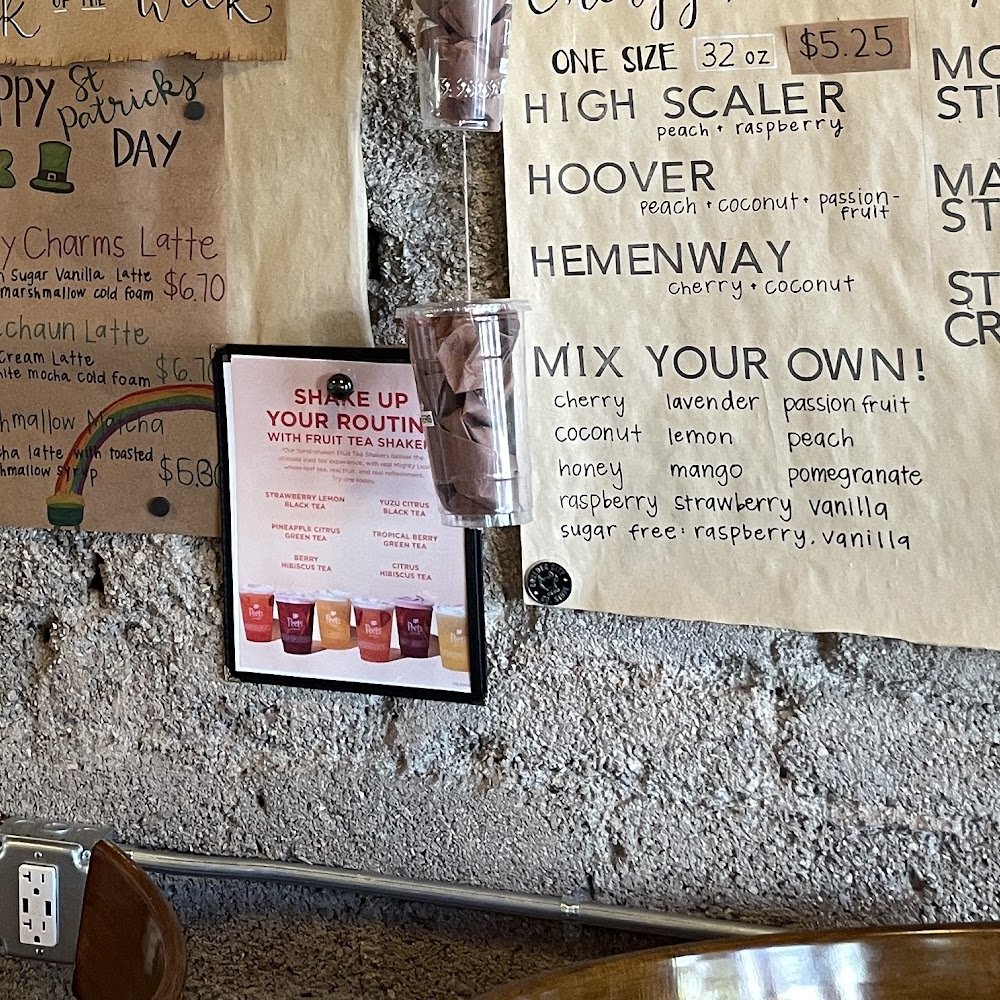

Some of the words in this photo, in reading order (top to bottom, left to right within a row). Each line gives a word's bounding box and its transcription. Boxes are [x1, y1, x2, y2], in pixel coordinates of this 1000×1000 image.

[799, 25, 893, 61] $5.25
[664, 81, 845, 118] SCALER
[657, 122, 709, 140] peach
[736, 117, 844, 141] raspberry
[529, 159, 715, 195] HOOVER
[640, 197, 697, 215] peach
[718, 195, 799, 213] coconut
[24, 226, 124, 260] Charms
[141, 227, 218, 260] Latte
[530, 241, 791, 277] HEMENWAY
[56, 267, 104, 282] Vanilla
[117, 269, 152, 282] Latte
[163, 269, 225, 301] $6.70
[93, 287, 117, 300] cold
[124, 287, 153, 301] foam
[668, 279, 743, 300] cherry
[765, 275, 855, 294] coconut
[85, 318, 149, 345] Latte
[52, 351, 95, 366] Latte
[379, 392, 408, 409] UP
[554, 392, 625, 416] cherry
[666, 393, 760, 411] lavender
[266, 411, 328, 430] YOUR
[268, 432, 301, 443] WITH
[306, 433, 342, 446] FRUIT
[348, 435, 372, 447] TEA
[555, 425, 642, 443] coconut
[667, 428, 733, 445] lemon
[110, 447, 154, 462] toasted
[788, 464, 923, 488] pomegranate
[266, 492, 316, 501] STRAWBERRY
[379, 499, 400, 508] YUZU
[402, 500, 430, 509] CITRUS
[559, 492, 658, 517] raspberry
[674, 495, 792, 521] strawberry
[809, 496, 888, 520] vanilla
[271, 524, 312, 533] PINEAPPLE
[313, 526, 341, 535] CITRUS
[285, 532, 311, 541] GREEN
[372, 531, 409, 540] TROPICAL
[412, 533, 438, 542] BERRY
[822, 527, 910, 550] vanilla
[281, 562, 315, 571] HIBISCUS
[380, 570, 416, 579] HIBISCUS
[392, 562, 419, 571] CITRUS
